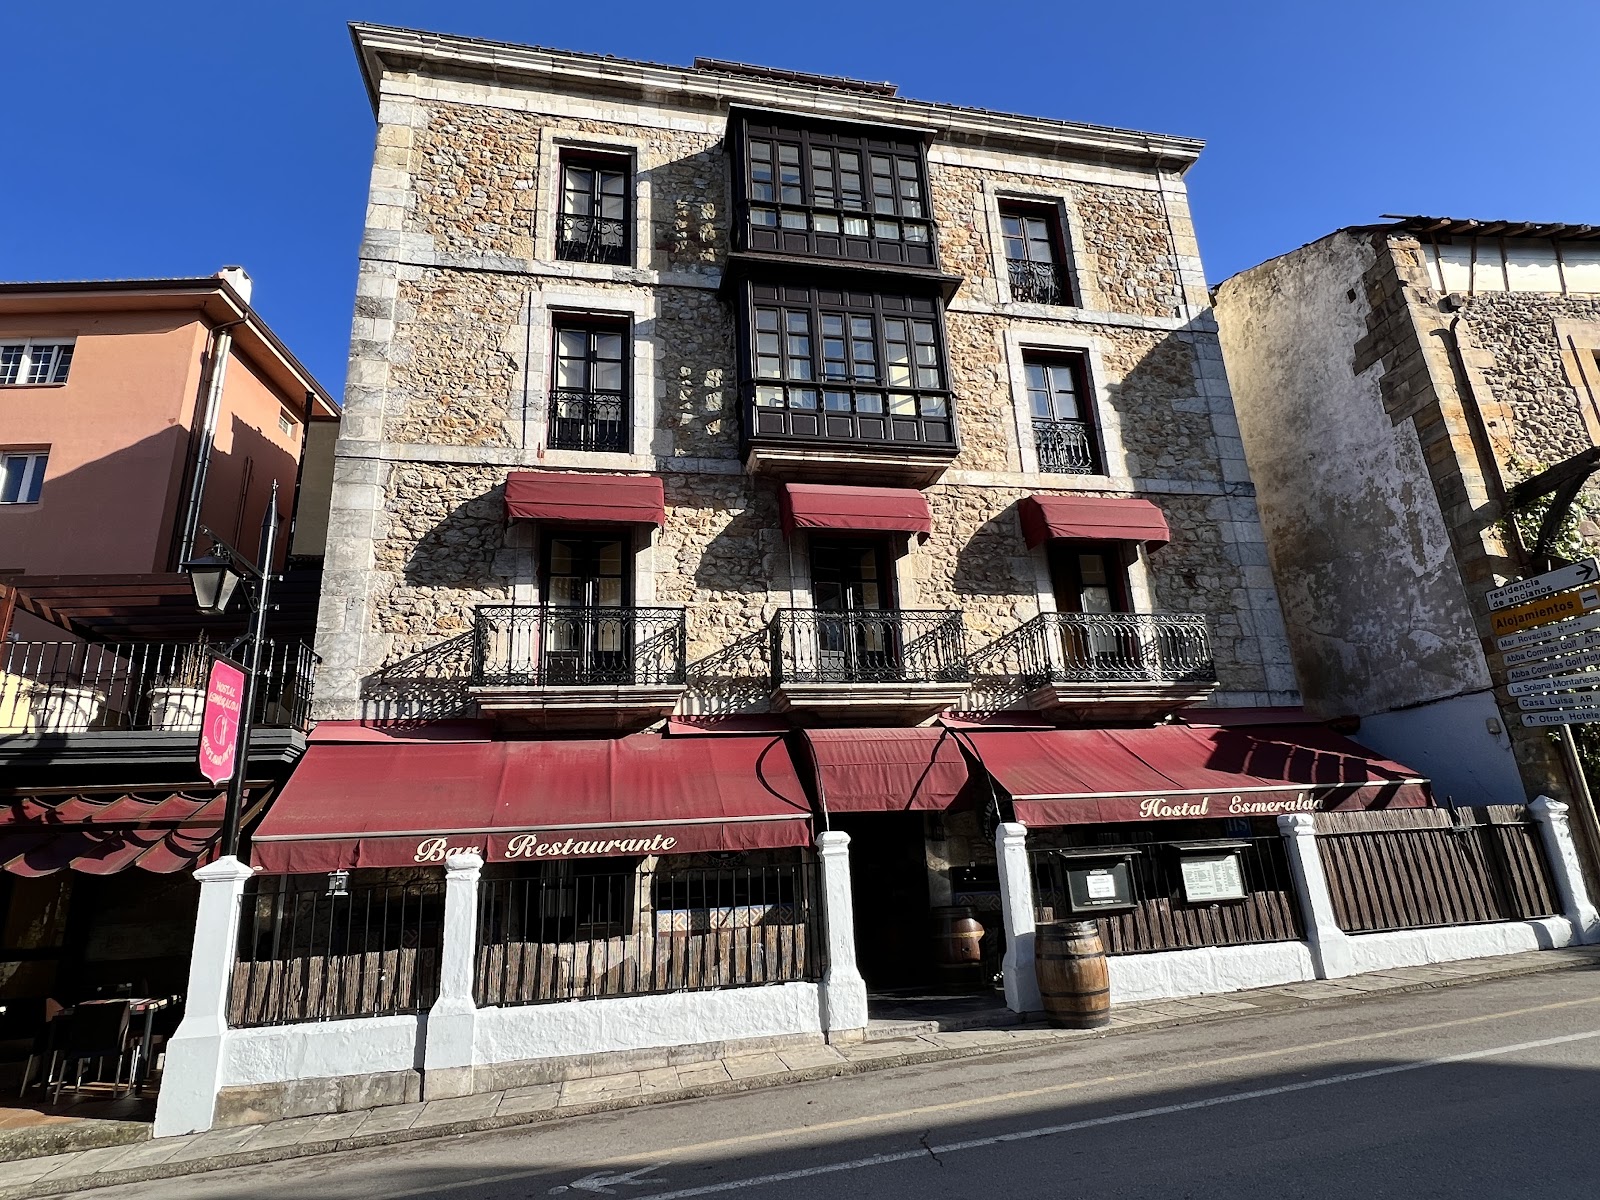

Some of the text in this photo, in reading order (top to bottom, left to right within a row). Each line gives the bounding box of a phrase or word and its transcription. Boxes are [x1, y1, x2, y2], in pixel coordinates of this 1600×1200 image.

[1490, 579, 1540, 600] residencia
[1493, 585, 1553, 608] de ancianos
[1496, 601, 1574, 629] Alojamientos
[1500, 639, 1514, 648] Mar
[1506, 654, 1526, 663] Abba
[1526, 646, 1559, 658] Comillas
[1560, 639, 1577, 650] Golf
[1511, 669, 1530, 679] Abba
[1531, 662, 1564, 675] Comillas
[1565, 657, 1582, 667] Golf
[1511, 675, 1600, 694] La Solana Montañesa
[1521, 694, 1593, 707] Casa Luisa AR
[1539, 714, 1565, 723] Otros
[1139, 792, 1324, 818] Hostal Esmeralda
[414, 833, 678, 863] Bar Restaurante
